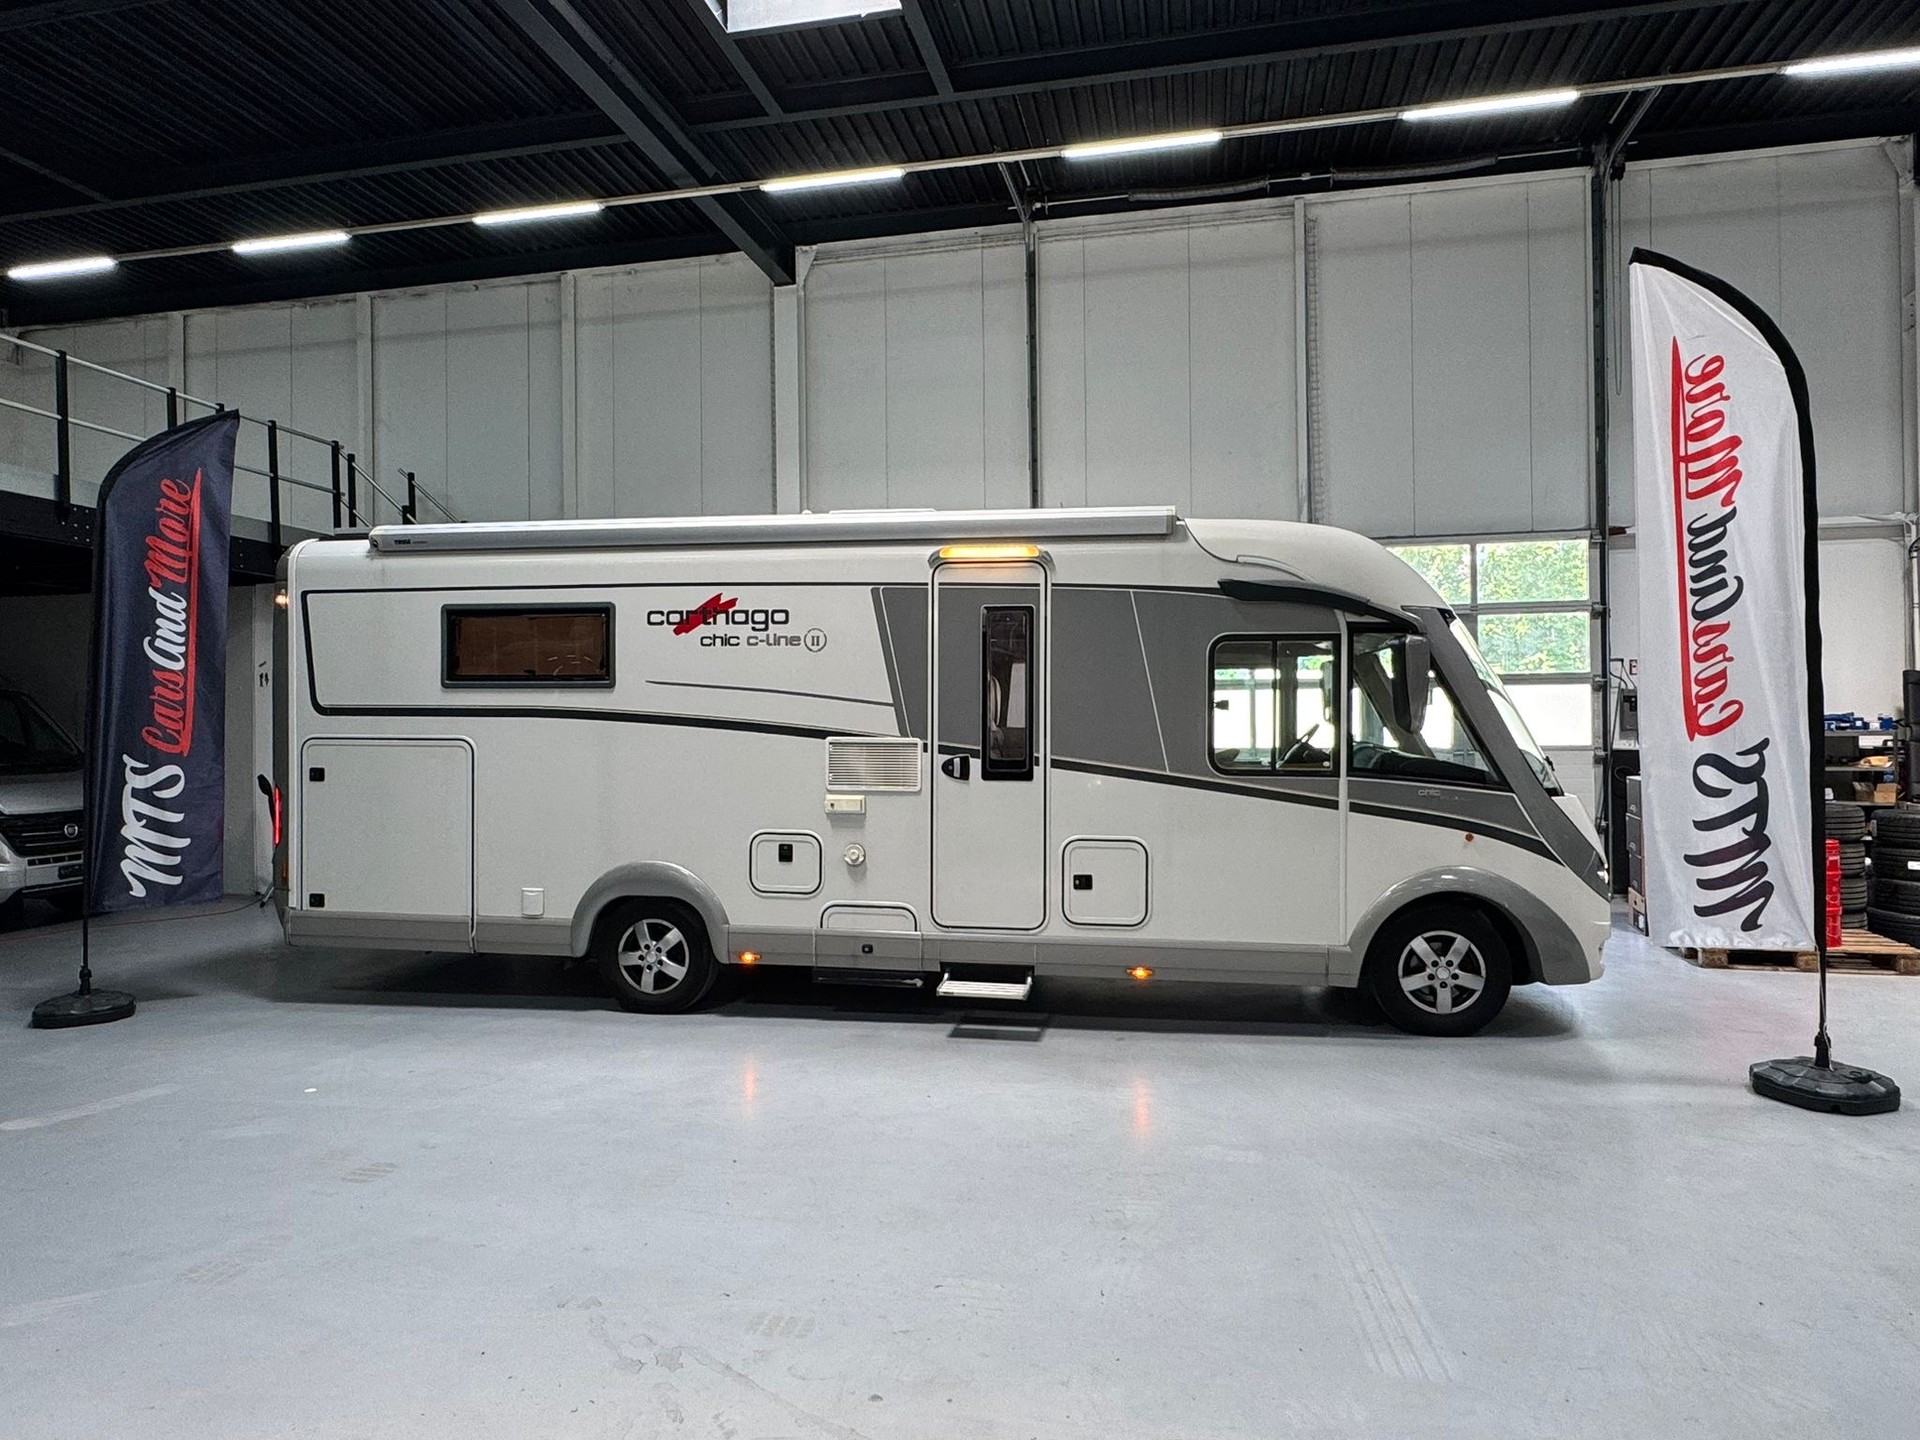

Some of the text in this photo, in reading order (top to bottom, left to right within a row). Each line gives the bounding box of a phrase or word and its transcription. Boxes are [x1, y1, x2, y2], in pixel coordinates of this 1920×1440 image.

[646, 608, 790, 632] carthago
[700, 633, 740, 647] chic
[746, 633, 802, 647] c-line
[120, 753, 191, 898] MTS
